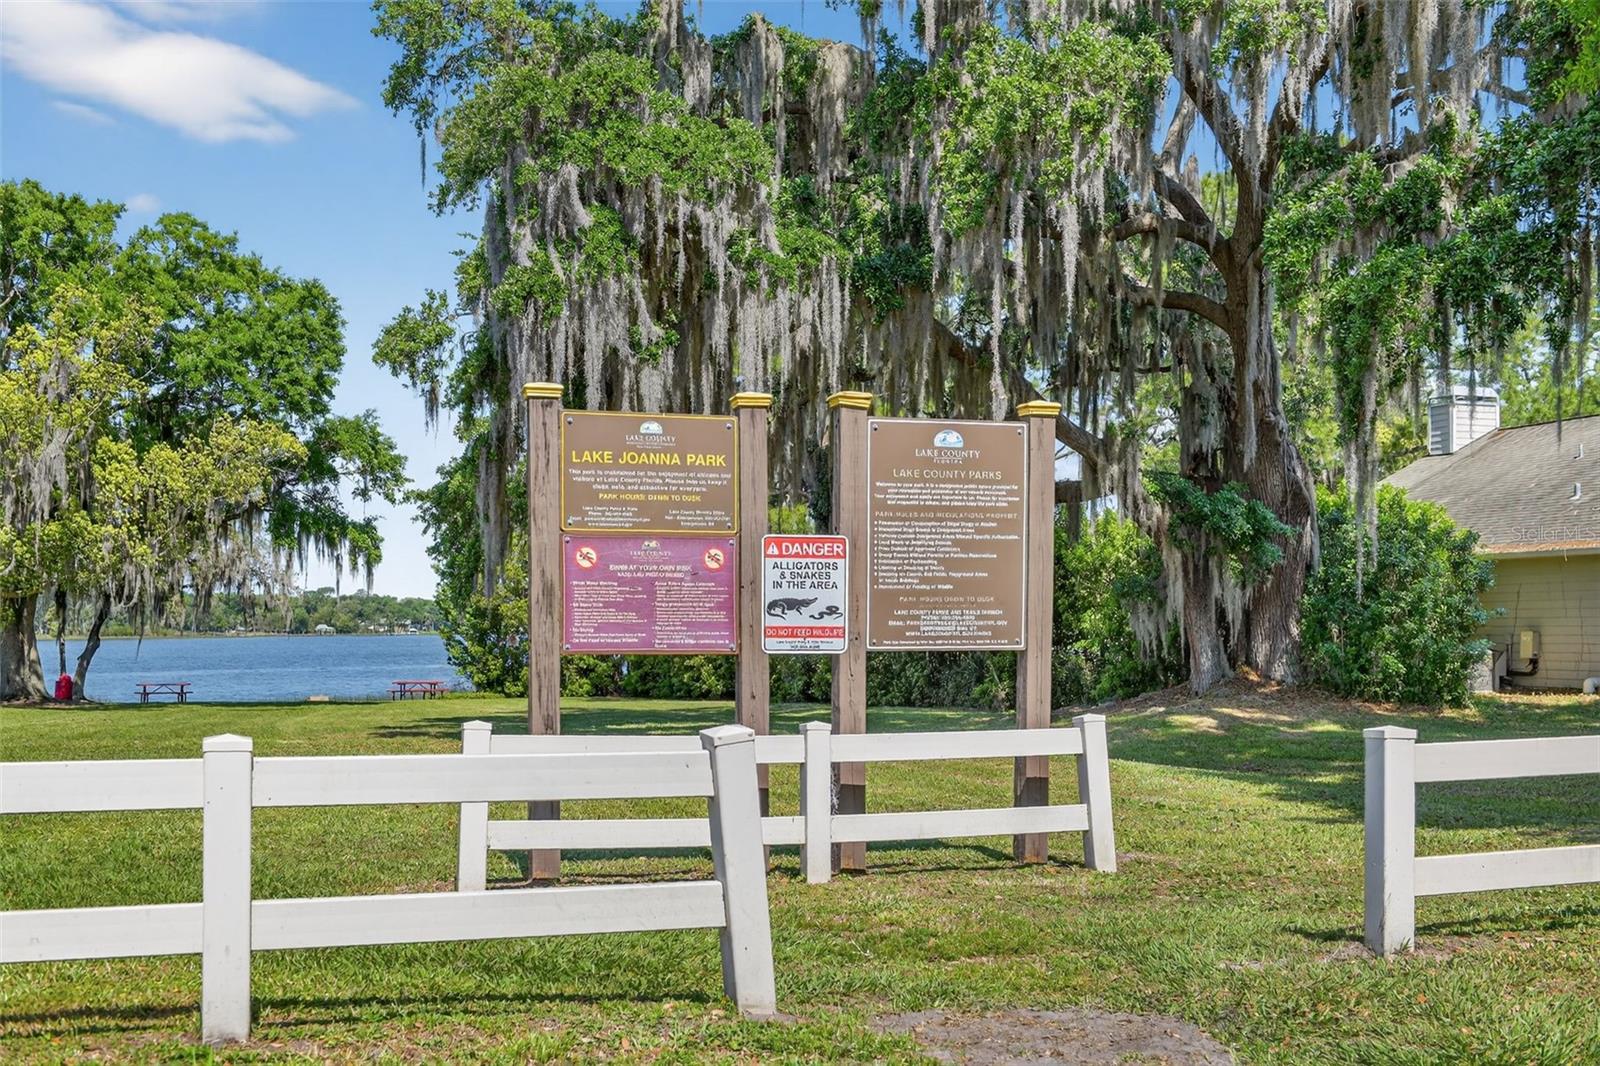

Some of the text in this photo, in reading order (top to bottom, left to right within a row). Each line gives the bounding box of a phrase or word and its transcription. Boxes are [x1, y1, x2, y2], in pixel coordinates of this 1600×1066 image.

[915, 448, 981, 458] LAKE COUNTY
[572, 450, 727, 467] LAKE JOANNA PARK
[893, 469, 1002, 480] LAKE COUNTY PARKS
[599, 493, 618, 501] PARK
[671, 494, 680, 502] TO
[682, 494, 702, 502] DUSK
[782, 542, 844, 556] DANGER
[772, 562, 839, 570] ALLIGATORS
[779, 571, 831, 580] & SNAKES
[772, 581, 838, 589] IN THE AREA
[766, 628, 845, 637] DO NOT FEED WILDLIFE
